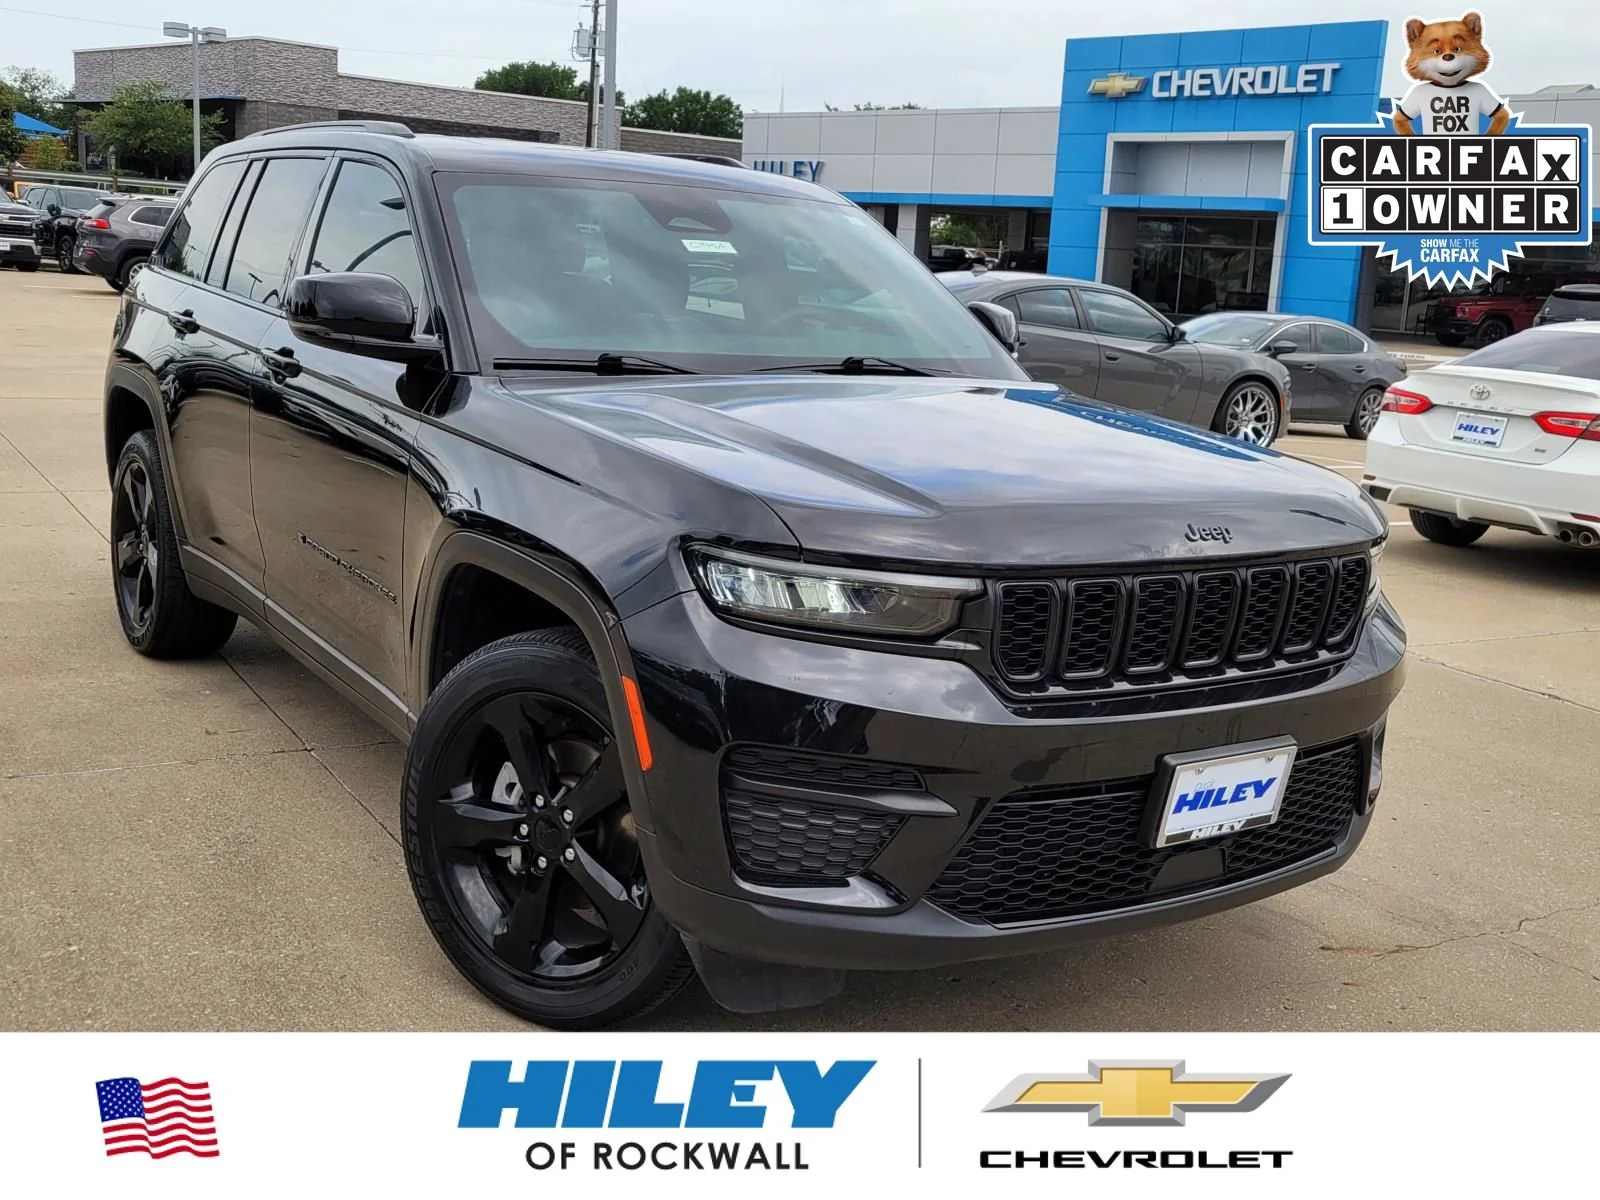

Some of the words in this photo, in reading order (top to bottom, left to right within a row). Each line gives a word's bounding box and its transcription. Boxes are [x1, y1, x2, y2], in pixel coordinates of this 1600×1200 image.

[1152, 63, 1341, 98] CHEVROLET
[1457, 423, 1501, 436] HILEY
[1185, 523, 1233, 544] Jeep
[1172, 777, 1278, 815] HILEY
[1190, 819, 1247, 840] HILEY
